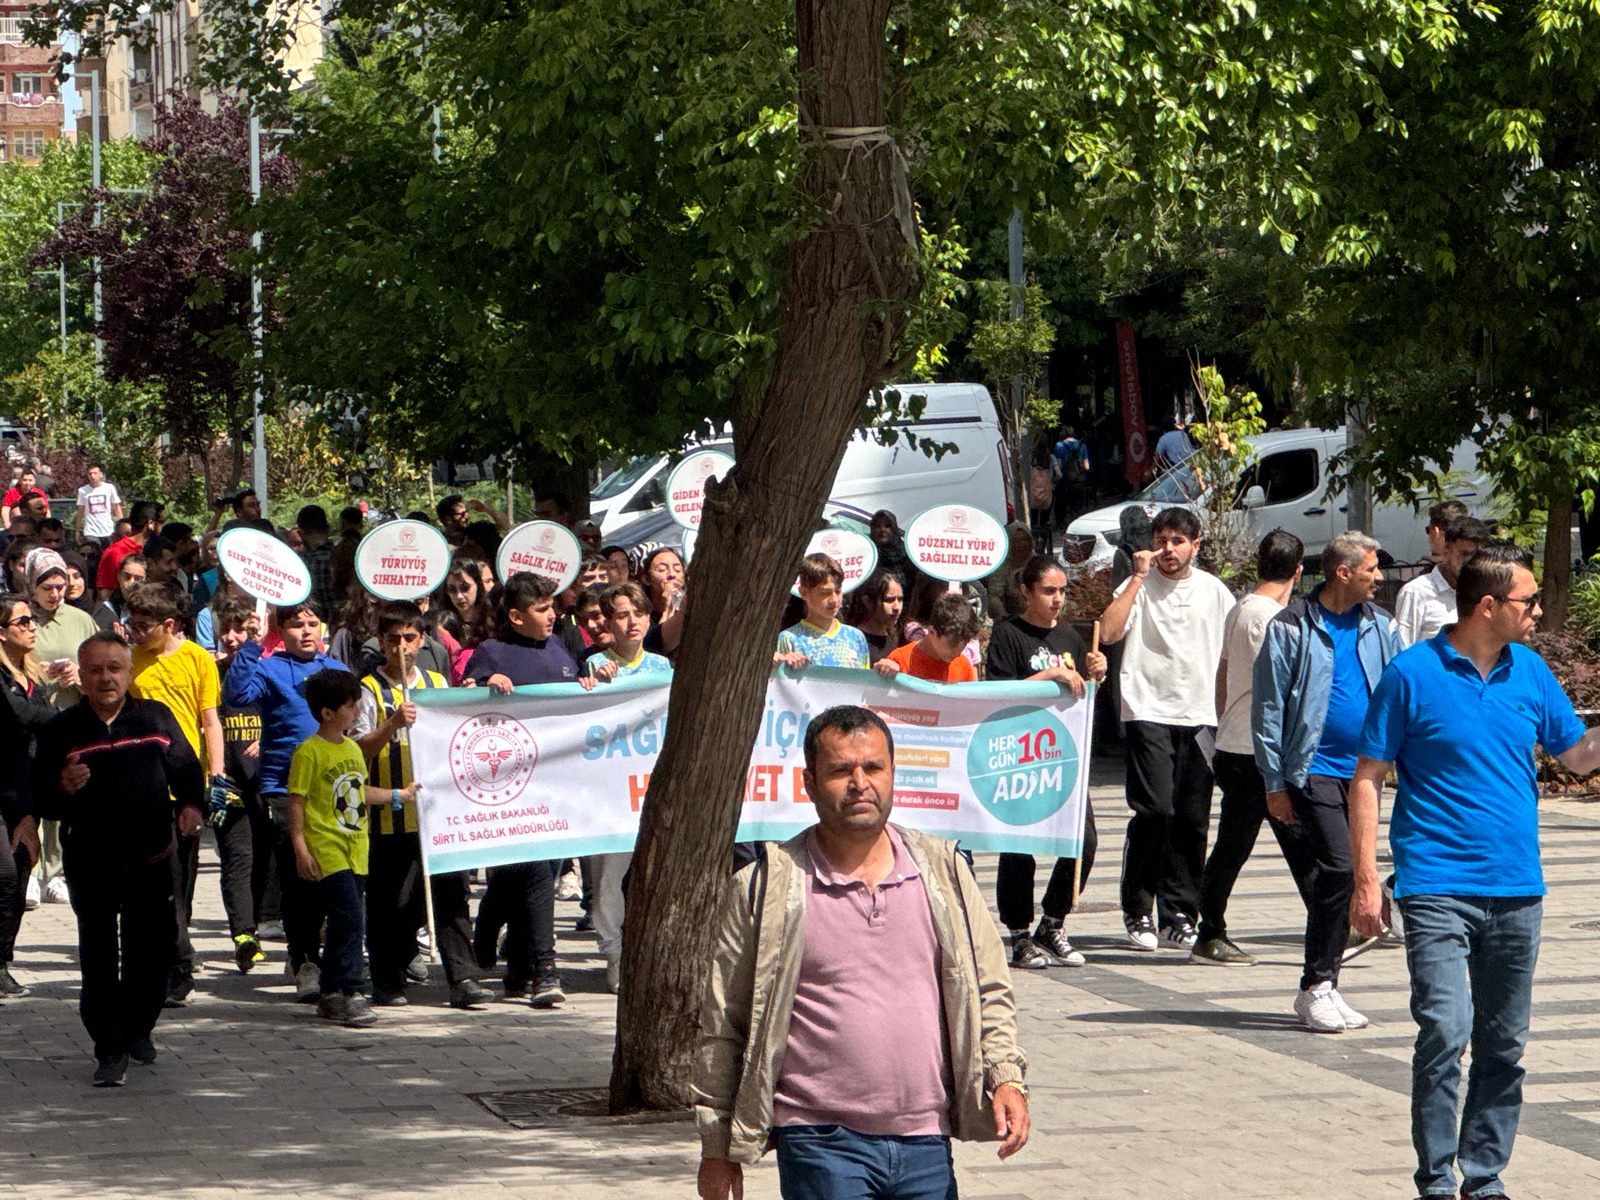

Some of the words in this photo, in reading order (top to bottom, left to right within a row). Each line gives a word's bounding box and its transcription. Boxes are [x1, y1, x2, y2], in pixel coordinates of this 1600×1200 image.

[918, 535, 964, 550] DÜZENLİ
[967, 538, 995, 551] YÜRÜ
[381, 555, 427, 573] YÜRÜYÜŞ
[510, 552, 545, 568] SAĞLIK
[845, 555, 864, 567] SEÇ
[920, 550, 968, 565] SAĞLIKLI
[971, 555, 992, 566] KAL
[243, 567, 284, 590] OBEZİTE
[255, 562, 302, 586] YÜRÜYOR
[765, 699, 818, 758] İÇİ
[988, 734, 1016, 753] HER
[1017, 727, 1056, 764] 10
[1044, 748, 1062, 759] bin
[988, 750, 1016, 769] GÜN
[464, 811, 499, 824] SAĞLIK
[501, 805, 550, 819] BAKANLIĞI
[459, 831, 467, 842] İL
[469, 828, 506, 841] SAĞLIK
[508, 819, 569, 836] MÜDÜRLÜĞÜ
